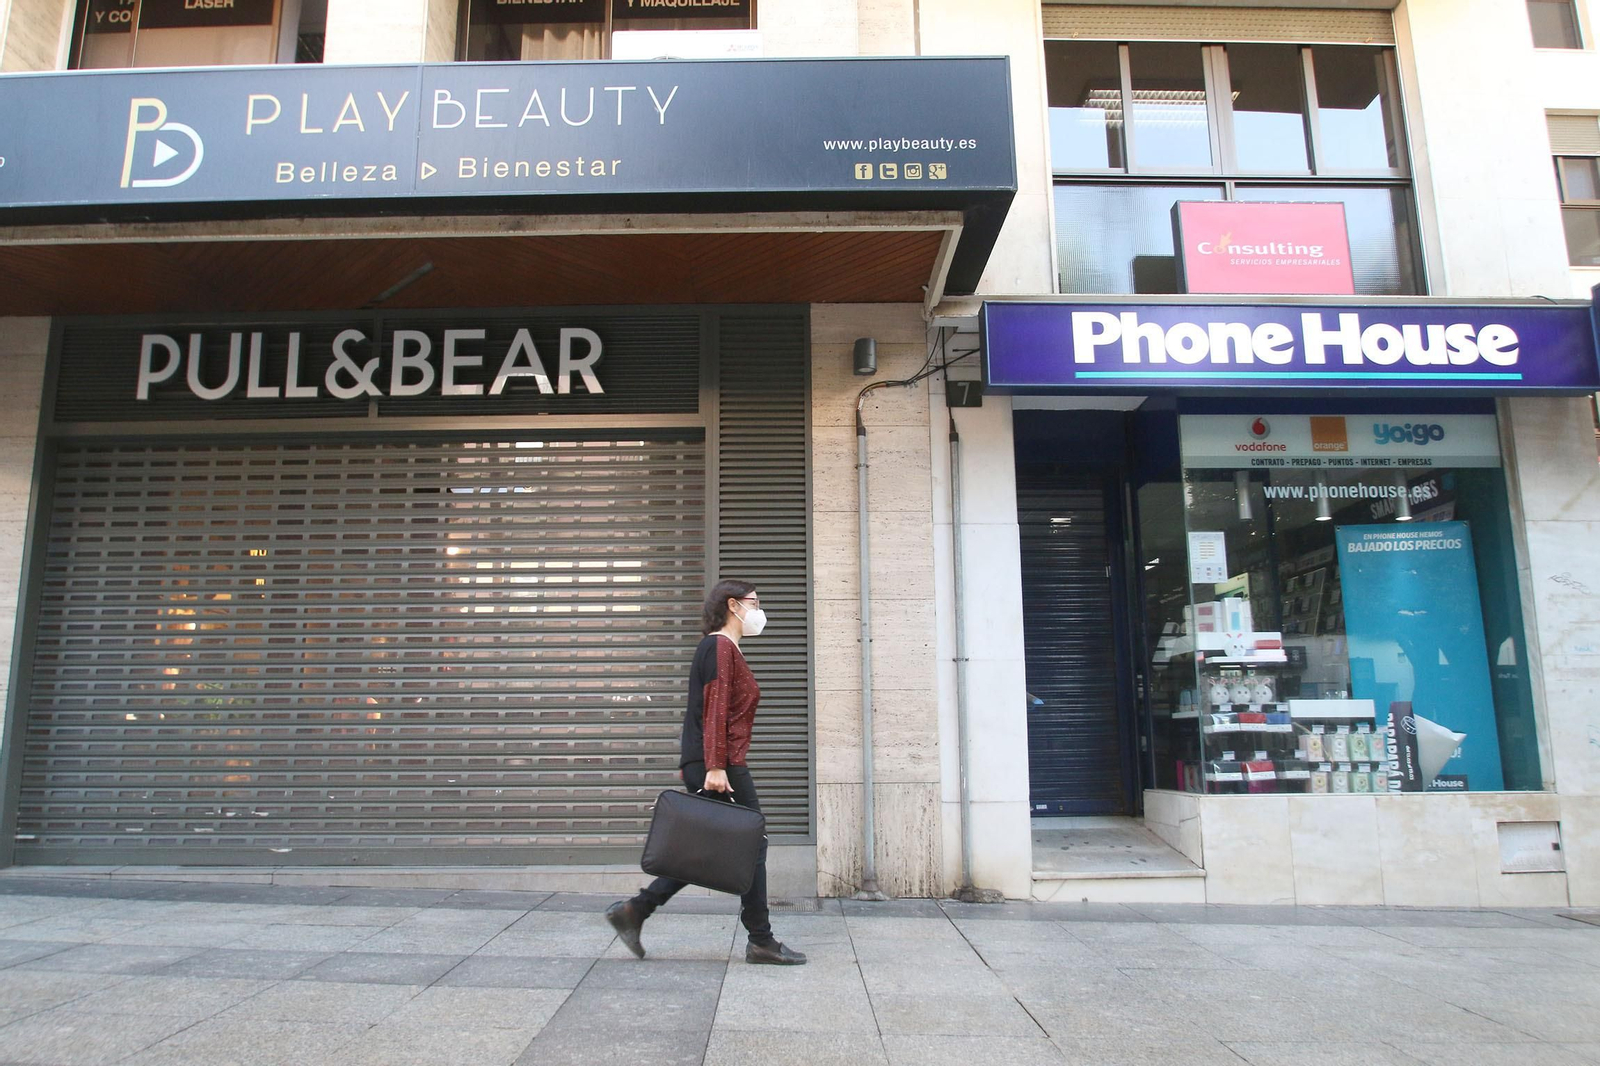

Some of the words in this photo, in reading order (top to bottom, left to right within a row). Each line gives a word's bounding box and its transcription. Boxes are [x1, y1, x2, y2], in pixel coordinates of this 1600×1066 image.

[95, 11, 104, 23] Y
[108, 10, 133, 23] CO
[245, 91, 409, 135] PLAY
[432, 85, 679, 129] BEAUTY
[823, 137, 977, 152] www.playbeauty.es
[276, 161, 398, 183] Belleza
[458, 156, 622, 178] Bienestar
[1197, 241, 1324, 258] Consulting
[1275, 258, 1341, 266] EMPRESARIALES
[1071, 311, 1294, 365] Phone
[1300, 312, 1520, 366] House
[136, 327, 605, 400] PULL&BEAR
[957, 382, 970, 405] 7
[1373, 423, 1445, 446] yoigo
[1235, 442, 1287, 452] vodafone
[1313, 442, 1345, 451] orange
[1251, 458, 1285, 466] CONTRATO
[1291, 458, 1321, 466] PREPAGO
[1328, 458, 1354, 466] PUNTOS
[1361, 458, 1391, 466] INTERNET
[1398, 458, 1432, 466] EMPRESAS
[1263, 482, 1431, 502] www.phonehouse.es
[1396, 531, 1418, 539] HOUSE
[1347, 541, 1392, 553] BAJADO
[1393, 540, 1414, 551] LOS
[1415, 538, 1462, 550] PRECIOS
[1432, 779, 1464, 788] House
